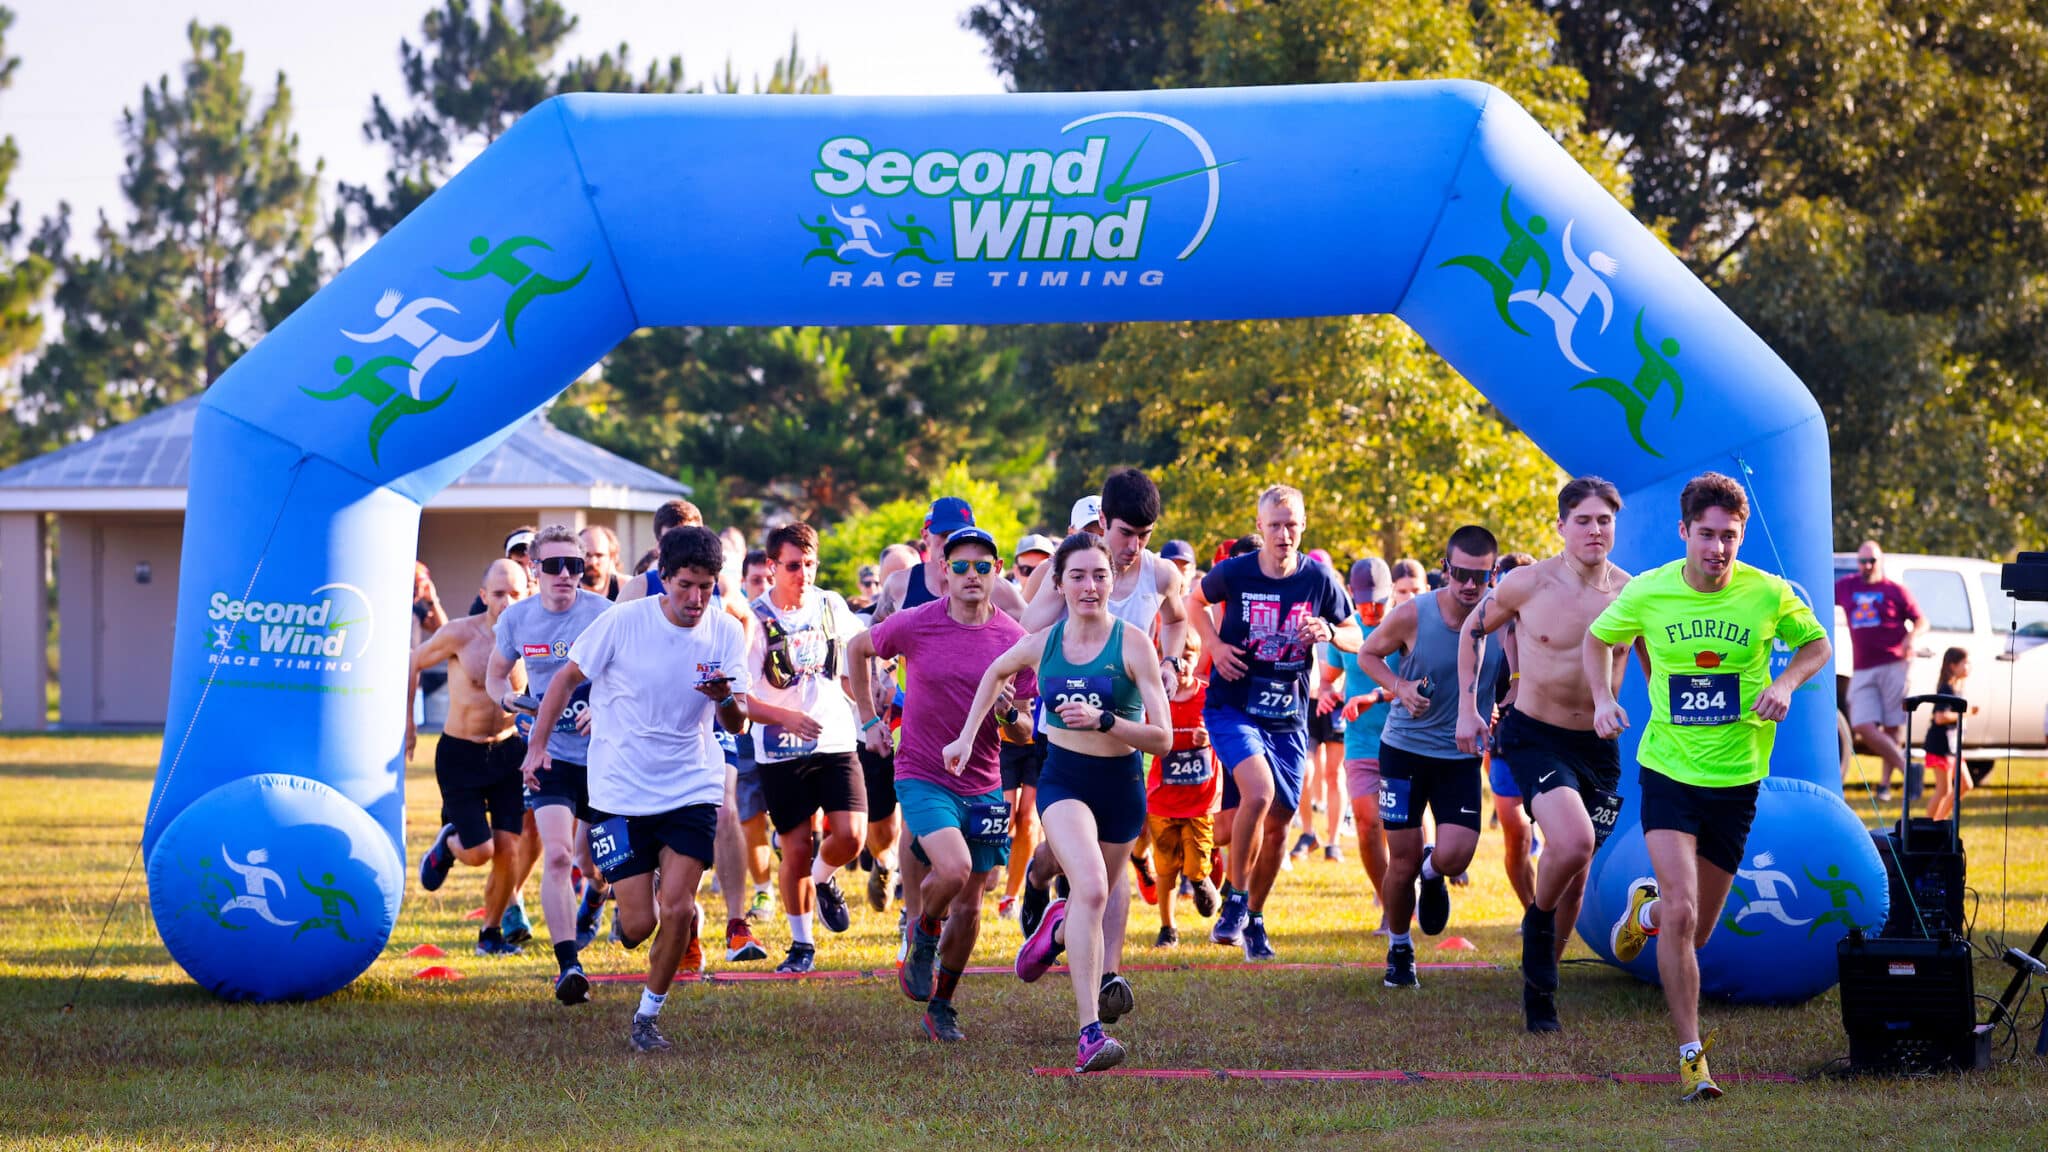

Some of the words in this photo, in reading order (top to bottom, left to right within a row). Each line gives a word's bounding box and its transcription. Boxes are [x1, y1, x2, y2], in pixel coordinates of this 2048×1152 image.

[812, 136, 1109, 196] Second
[951, 197, 1150, 260] Wind
[828, 270, 955, 287] RACE
[988, 269, 1165, 287] TIMING
[1242, 592, 1281, 602] FINISHER
[208, 591, 332, 626] Second
[260, 624, 347, 657] Wind
[1665, 619, 1751, 647] FLORIDA
[209, 654, 260, 666] RACE
[273, 658, 352, 672] TIMING
[1259, 691, 1293, 708] 279
[1680, 691, 1727, 710] 284
[1170, 759, 1203, 776] 248
[1591, 806, 1619, 826] 283
[981, 817, 1010, 835] 252
[592, 834, 617, 859] 251
